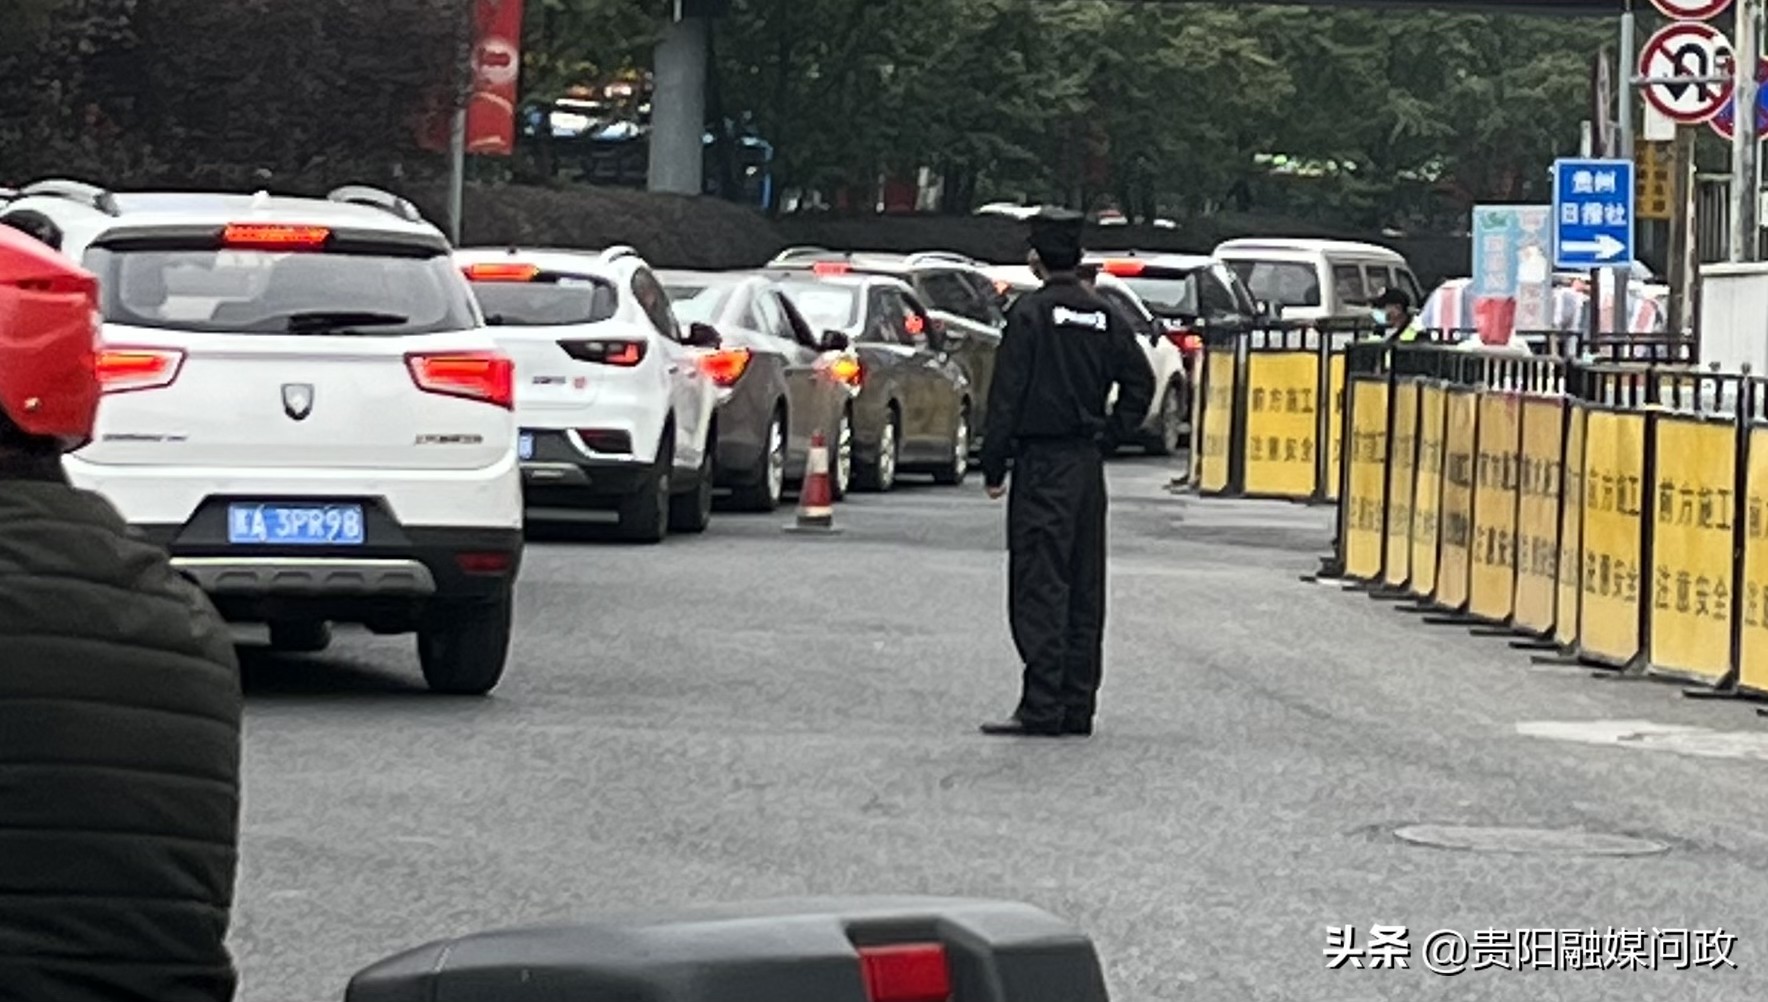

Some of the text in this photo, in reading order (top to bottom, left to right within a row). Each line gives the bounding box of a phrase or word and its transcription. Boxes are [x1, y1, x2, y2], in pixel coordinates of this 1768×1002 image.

[1658, 476, 1733, 531] 前方施工
[1655, 565, 1729, 620] 注意安全
